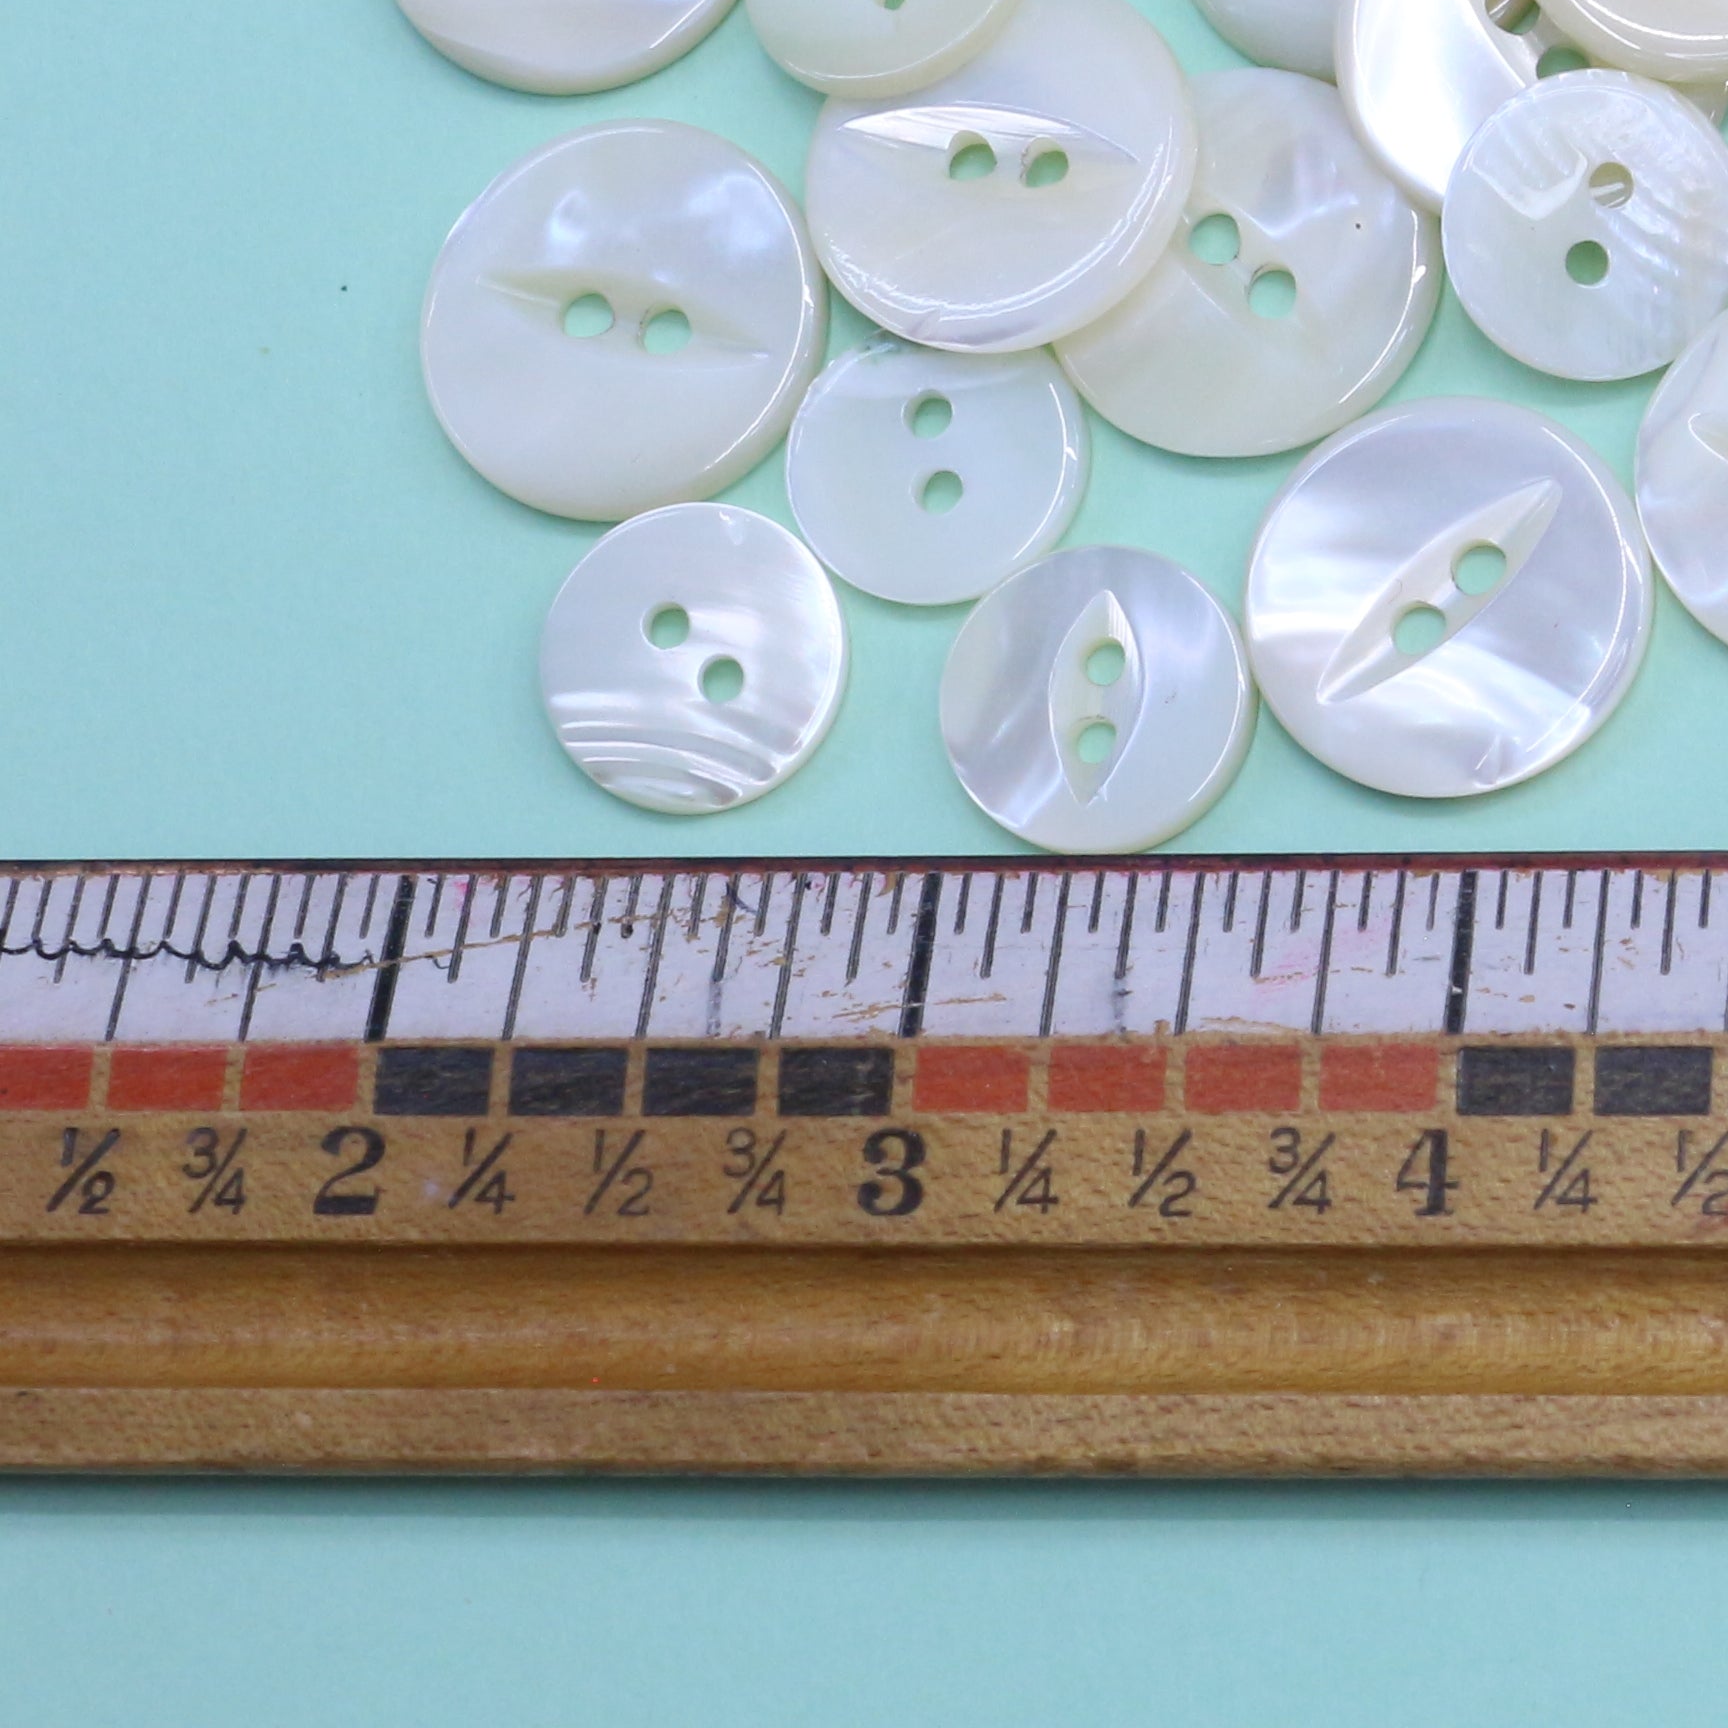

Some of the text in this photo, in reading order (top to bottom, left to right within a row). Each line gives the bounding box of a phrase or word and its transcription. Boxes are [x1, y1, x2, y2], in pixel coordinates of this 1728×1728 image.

[313, 1126, 386, 1217] 2
[857, 1127, 926, 1217] 3
[1396, 1128, 1459, 1217] 4
